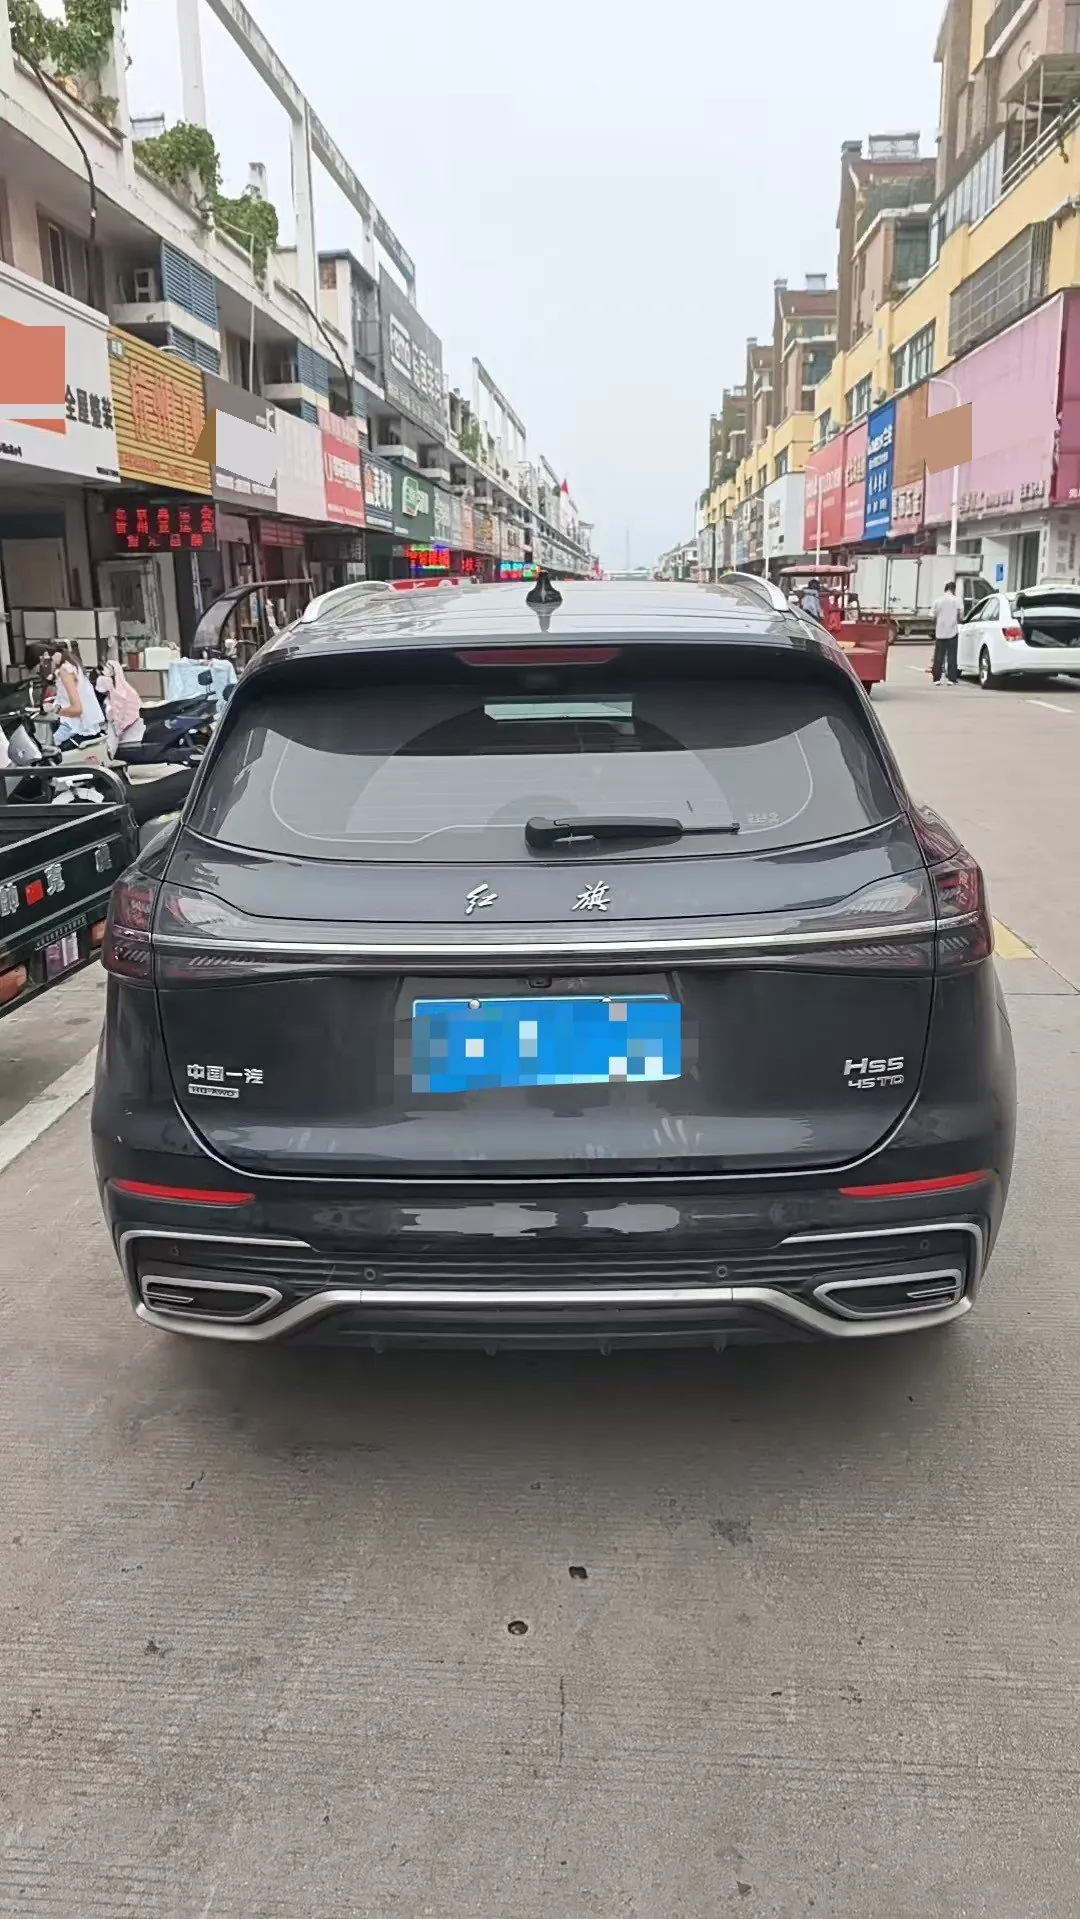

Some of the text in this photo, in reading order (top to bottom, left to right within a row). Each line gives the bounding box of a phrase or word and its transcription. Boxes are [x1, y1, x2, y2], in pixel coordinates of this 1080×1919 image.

[464, 880, 612, 916] 红旗
[186, 1063, 264, 1085] 中国一汽
[847, 1074, 905, 1089] 45TD
